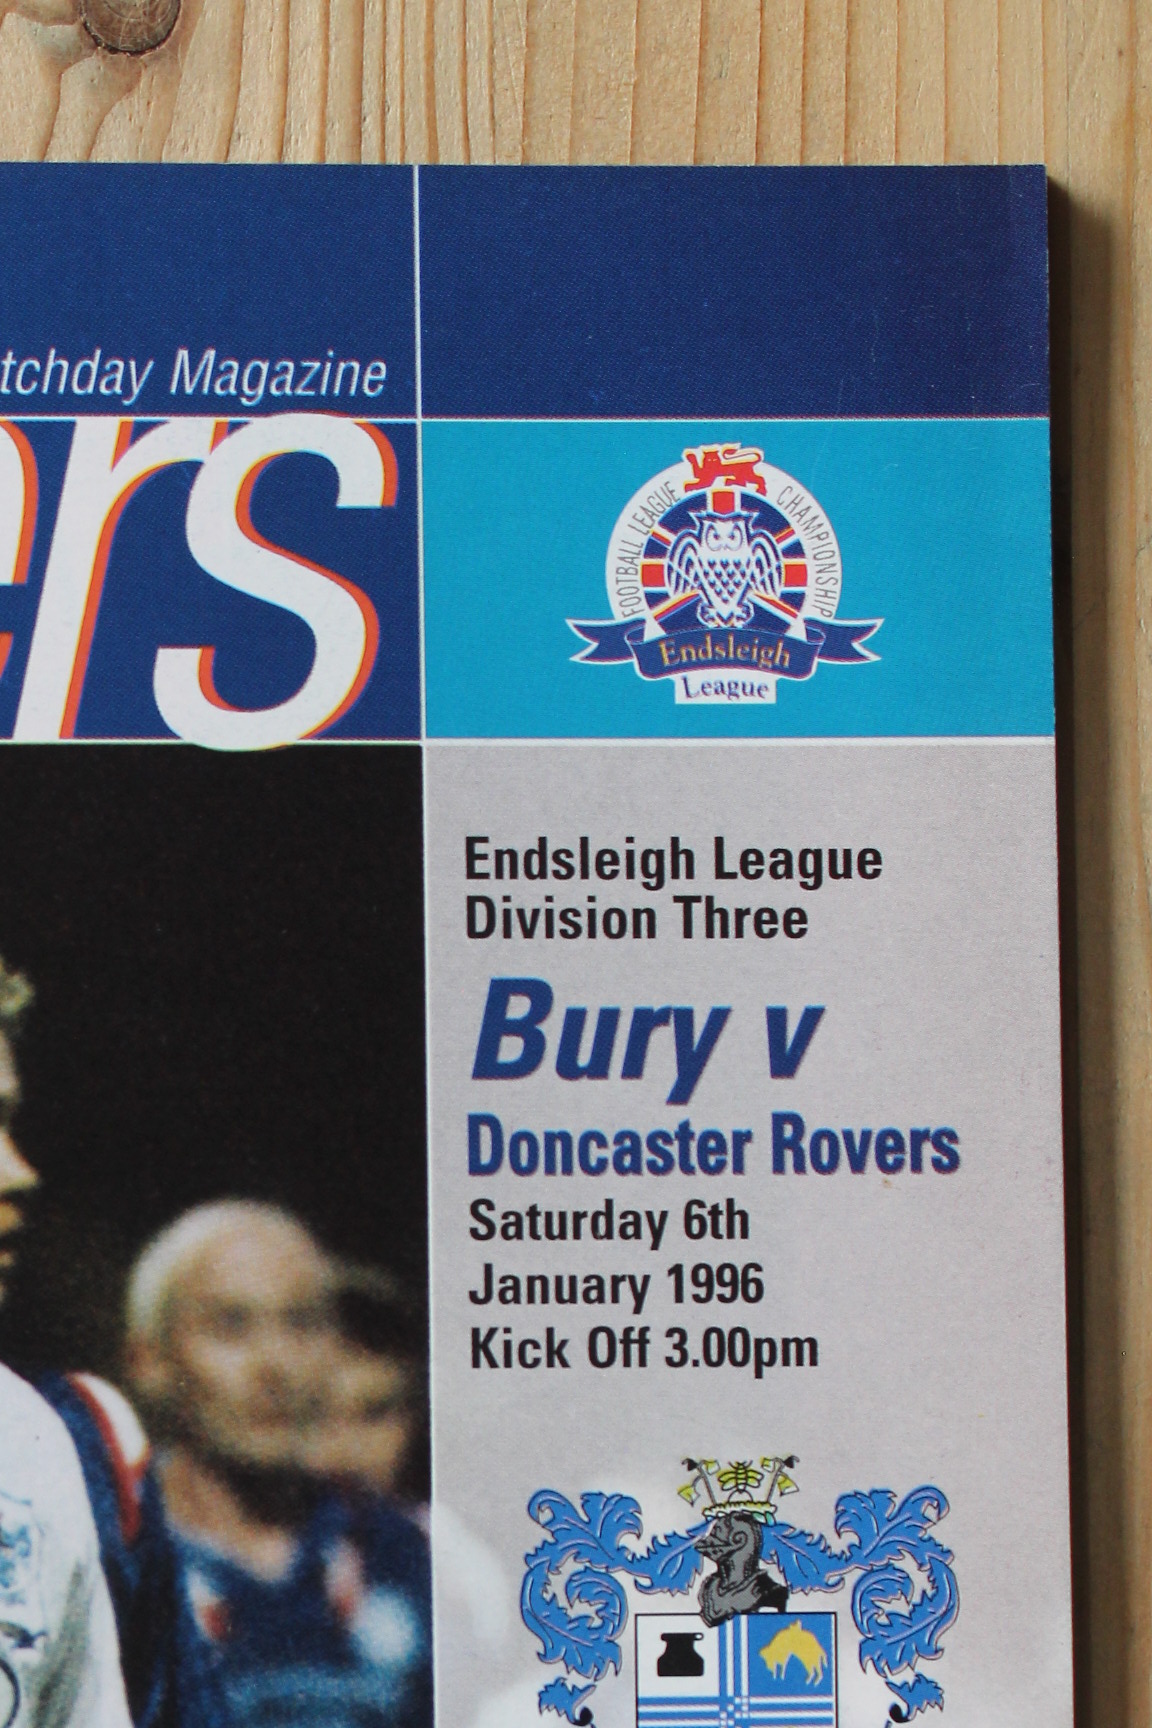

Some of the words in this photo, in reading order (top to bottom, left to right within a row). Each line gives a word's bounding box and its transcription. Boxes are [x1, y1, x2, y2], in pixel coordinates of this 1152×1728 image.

[168, 350, 388, 405] Magazine
[615, 538, 644, 618] FOOTBALL
[632, 481, 680, 534] LEAGUE
[776, 485, 838, 619] CHAMPIONSHIP
[658, 632, 791, 670] Endsleigh
[682, 676, 769, 701] League
[465, 836, 696, 891] Endsleigh
[713, 836, 883, 890] League
[466, 895, 658, 940] Division
[673, 895, 809, 940] Three
[471, 976, 732, 1106] Bury
[765, 1004, 826, 1080] v
[466, 1112, 753, 1176] Doncaster
[771, 1110, 961, 1176] Rovers
[468, 1198, 669, 1251] Saturday
[683, 1198, 750, 1240] 6th
[468, 1262, 651, 1314] January
[666, 1262, 765, 1305] 1996
[470, 1326, 571, 1369] Kick
[587, 1325, 651, 1368] Off
[664, 1326, 819, 1379] 3.00pm
